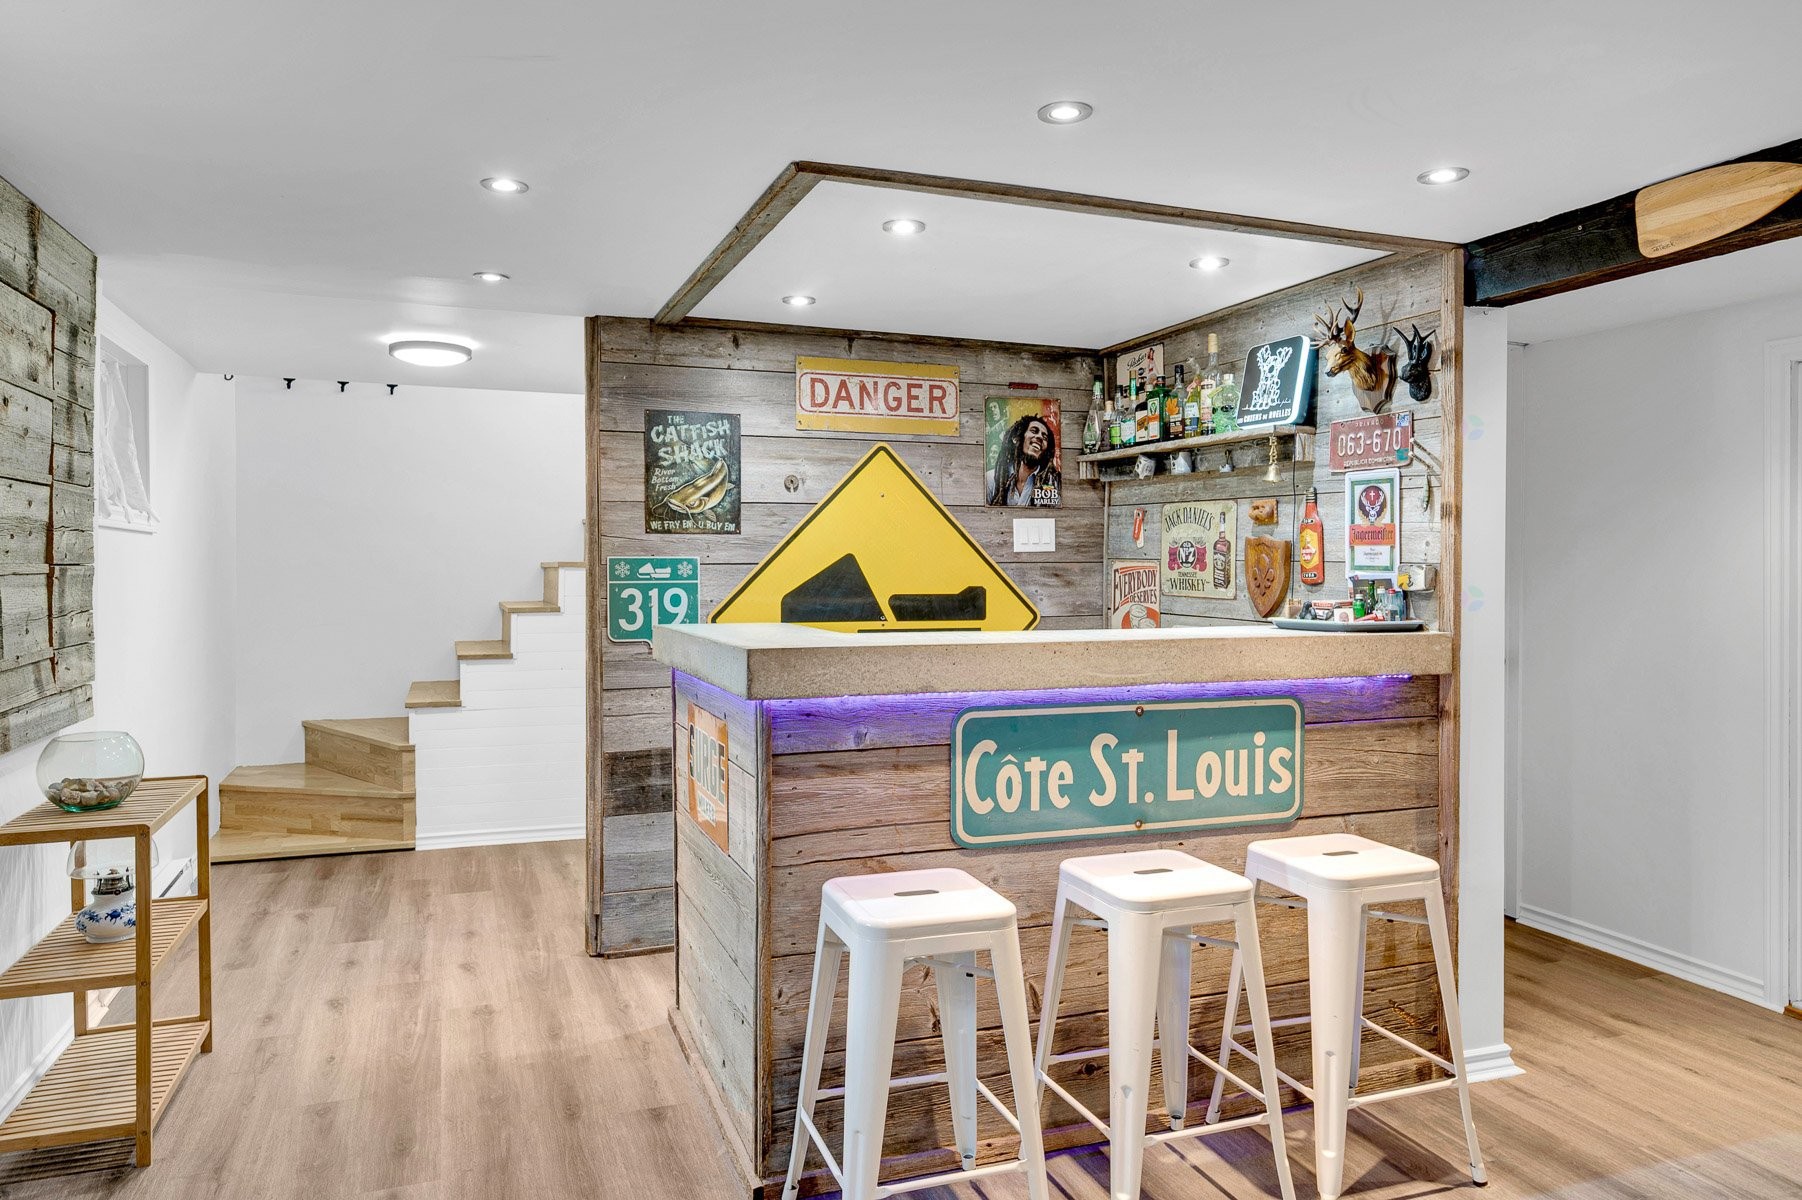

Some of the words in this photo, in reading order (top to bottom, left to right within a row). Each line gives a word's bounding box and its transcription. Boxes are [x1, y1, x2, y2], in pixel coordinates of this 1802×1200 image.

[810, 377, 947, 415] DANGER
[650, 419, 731, 443] CATFISH
[667, 415, 685, 424] THE
[658, 438, 729, 467] SHACK
[1337, 427, 1402, 457] 063-670
[651, 476, 679, 484] Bottom
[654, 467, 676, 476] River
[655, 483, 677, 491] Fresh
[1033, 488, 1059, 499] BOB
[650, 521, 662, 530] WE
[664, 520, 680, 530] FRY
[706, 521, 723, 531] BUY
[1165, 508, 1183, 533] JACK
[1113, 568, 1158, 615] EVERYBODY
[1129, 588, 1158, 605] DESERVES
[1169, 578, 1206, 592] WHISKEY
[618, 587, 689, 632] 319
[689, 723, 726, 807] SURGE
[963, 739, 1074, 815] Côte
[1088, 732, 1155, 807] St.
[1166, 729, 1293, 801] Louis
